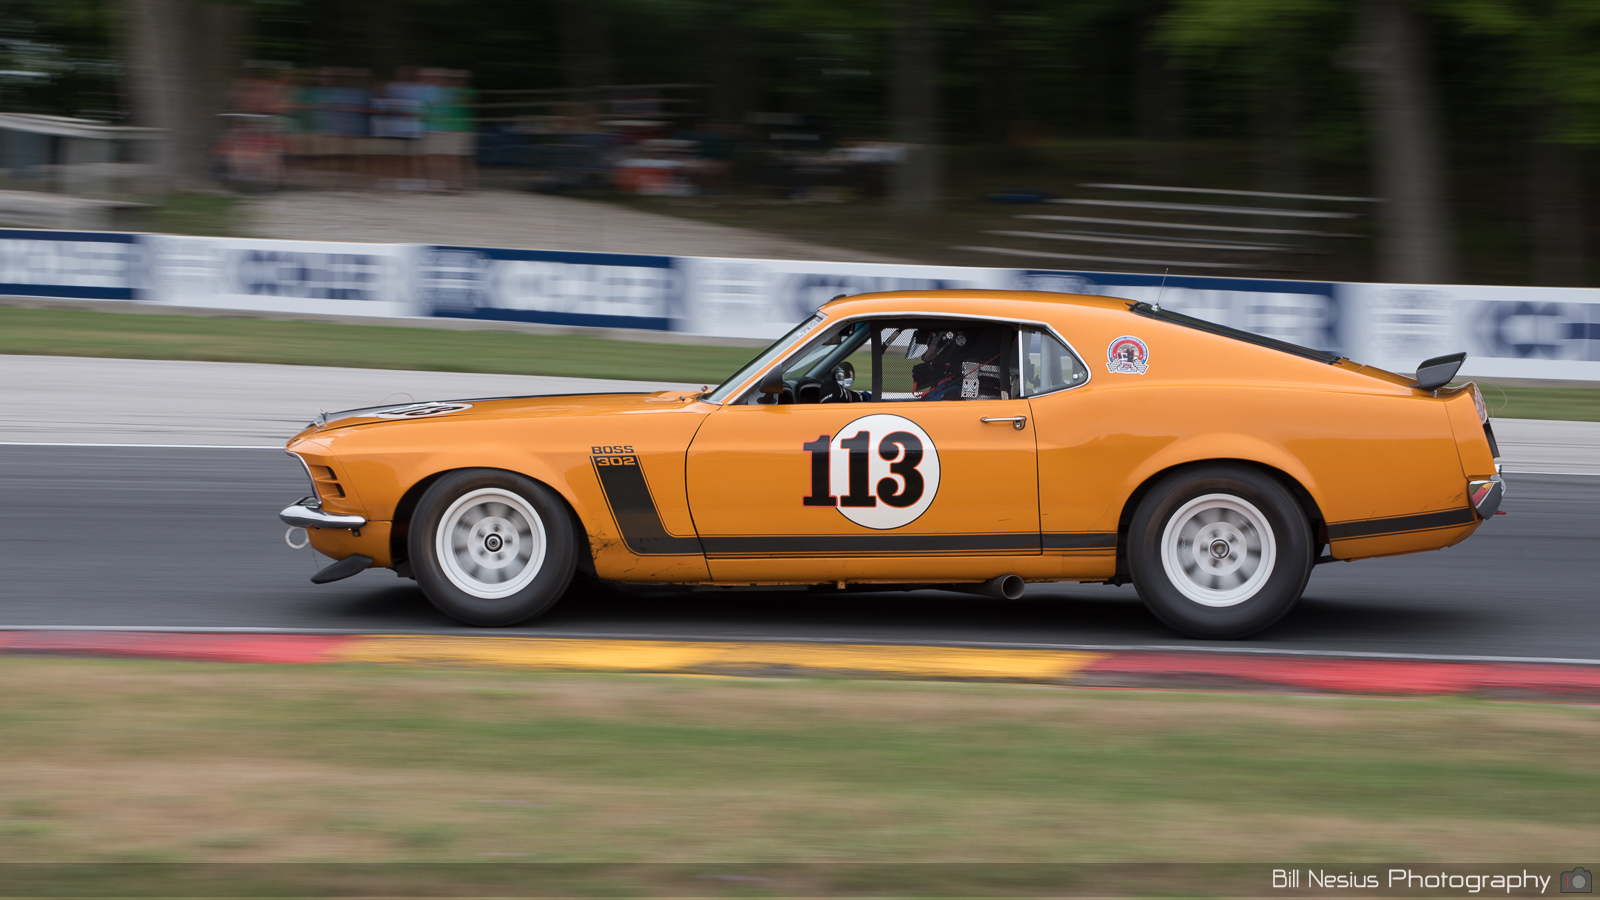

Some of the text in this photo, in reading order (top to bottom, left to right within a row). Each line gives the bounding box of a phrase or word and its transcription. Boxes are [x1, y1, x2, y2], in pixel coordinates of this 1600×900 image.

[591, 445, 635, 454] BOSS
[596, 456, 636, 466] 302
[802, 430, 925, 508] 113
